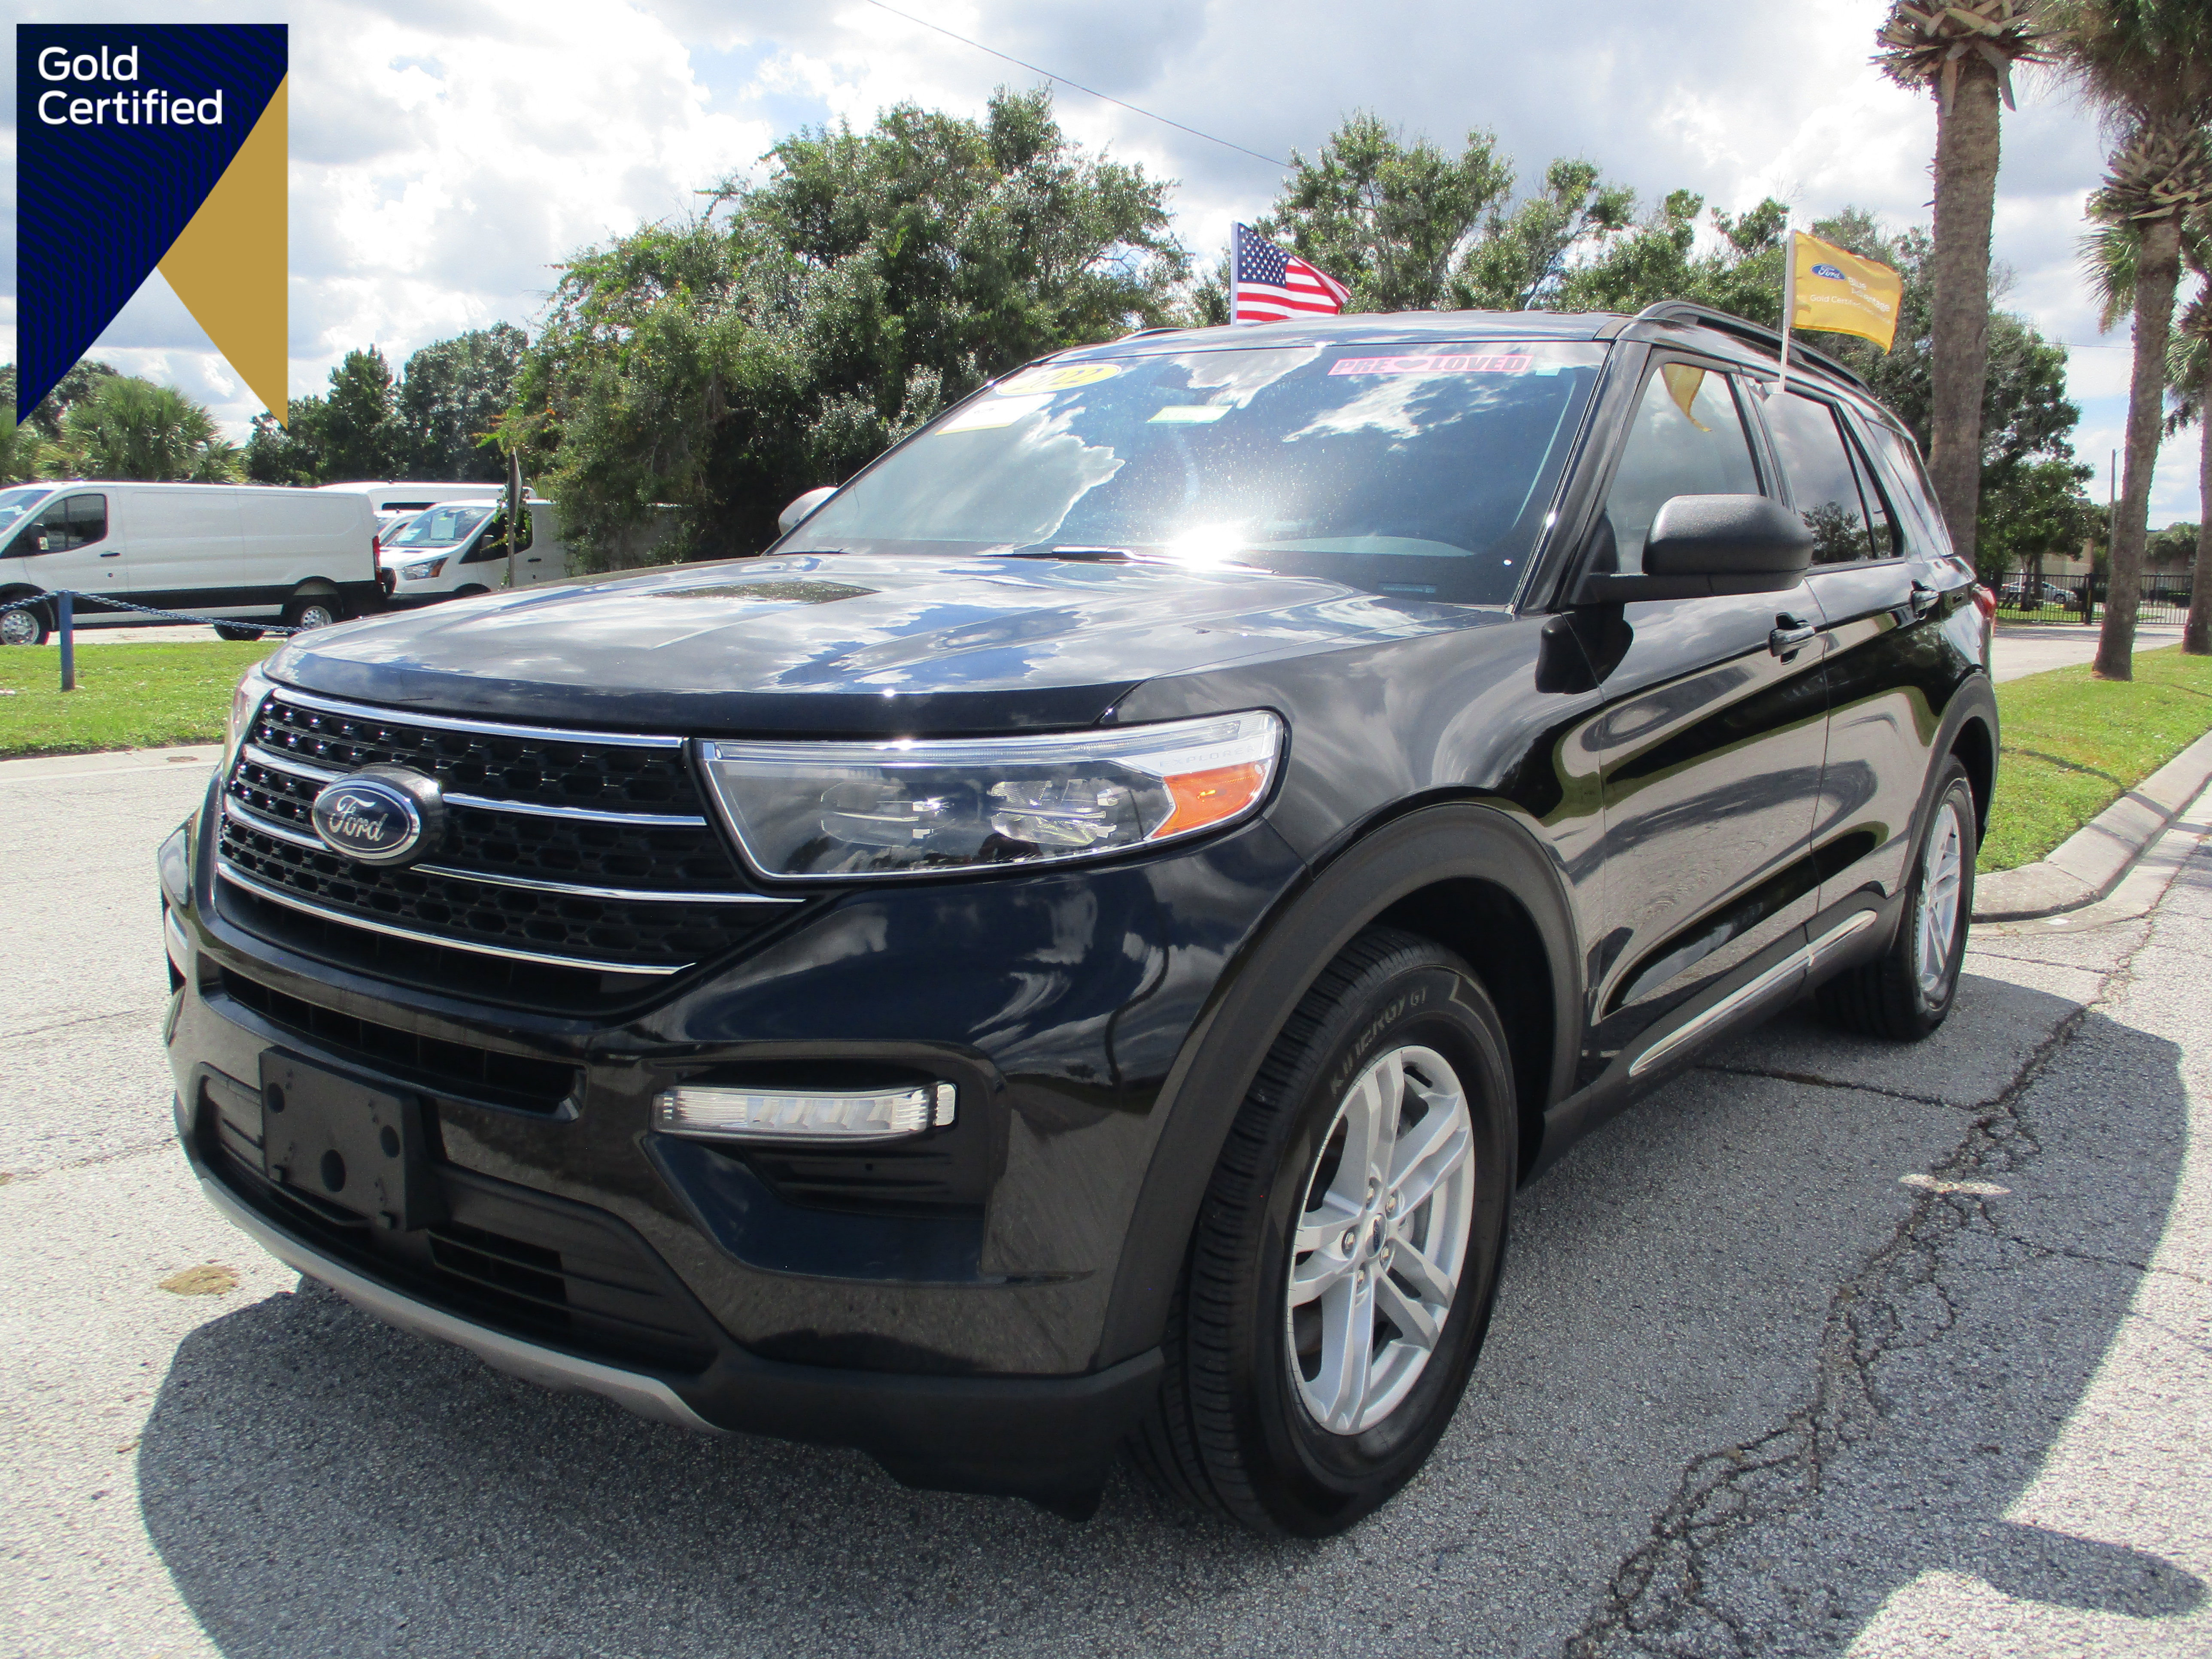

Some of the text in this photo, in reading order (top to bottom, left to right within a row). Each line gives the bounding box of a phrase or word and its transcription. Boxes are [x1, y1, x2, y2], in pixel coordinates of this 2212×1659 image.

[1818, 266, 1841, 279] Ford
[1334, 356, 1526, 373] PRE LOVED
[1159, 745, 1255, 767] EXPLORER
[329, 795, 389, 842] Ford
